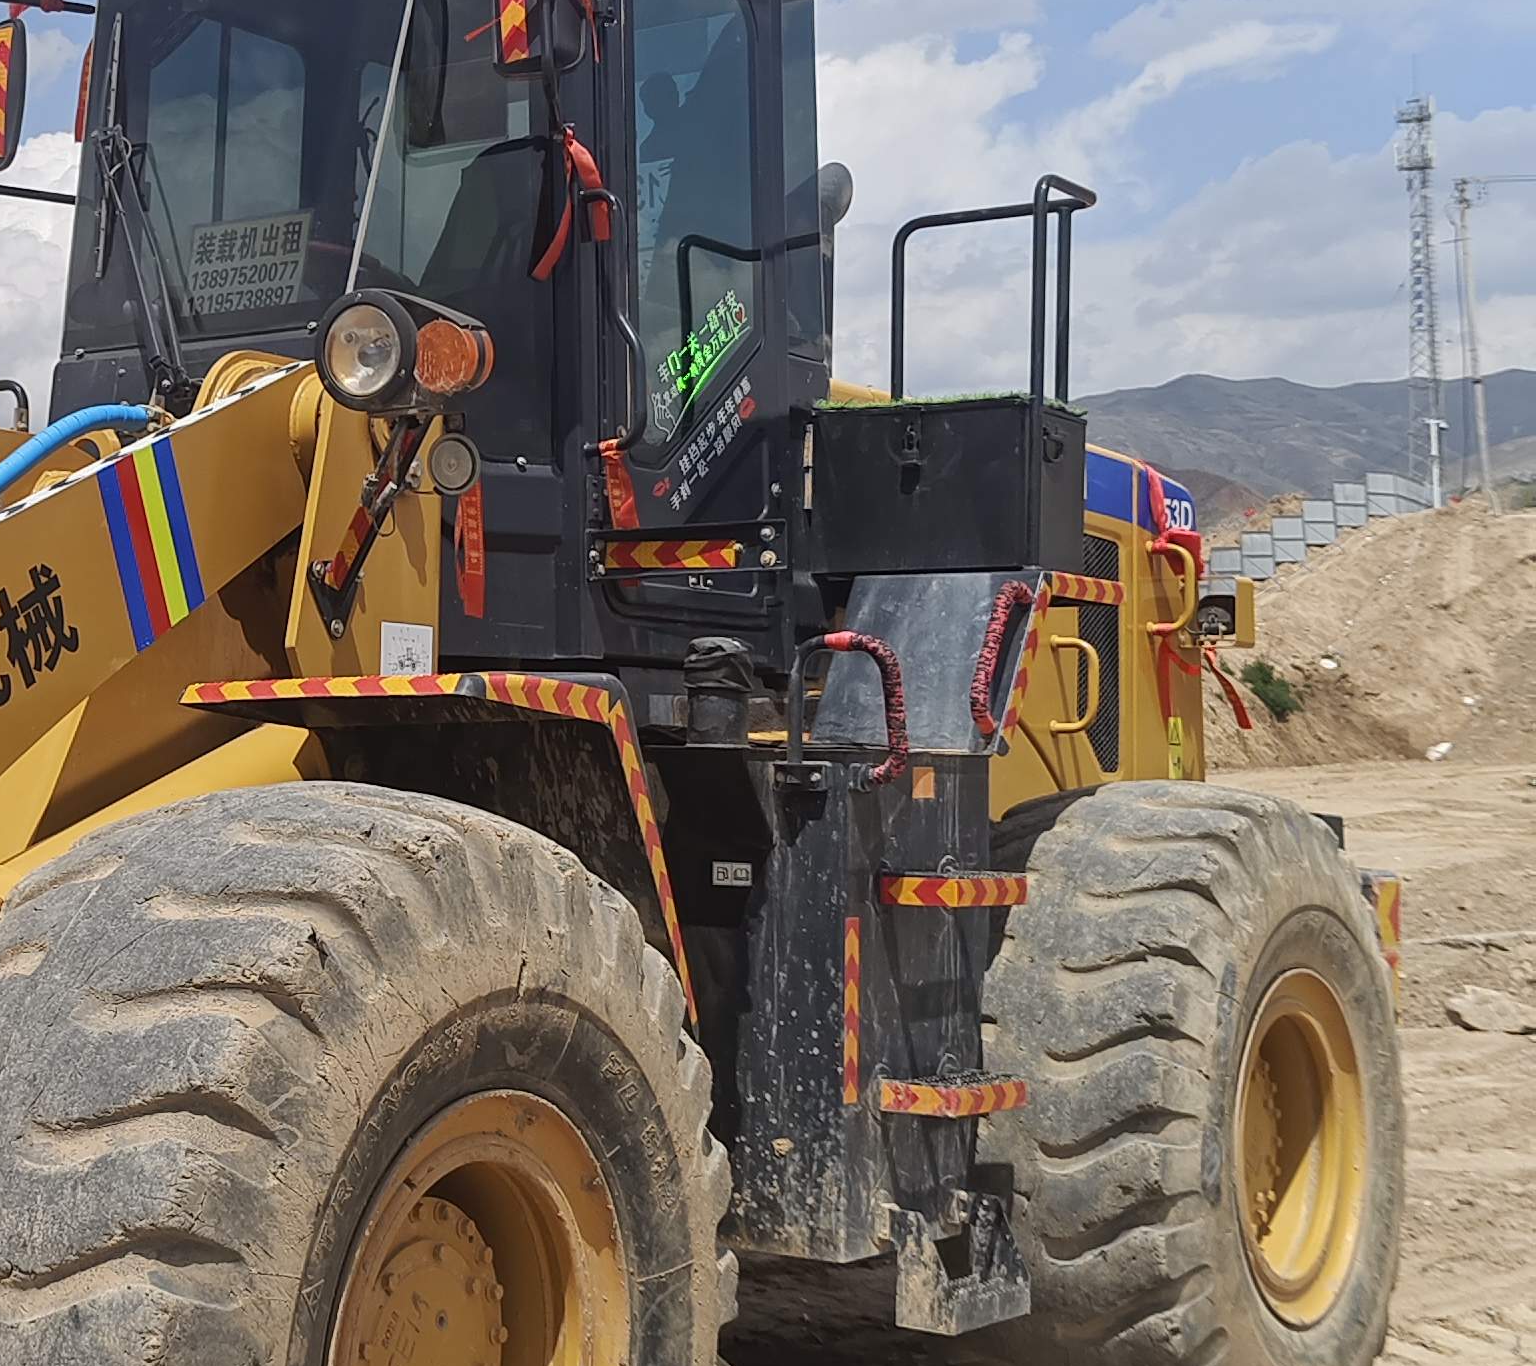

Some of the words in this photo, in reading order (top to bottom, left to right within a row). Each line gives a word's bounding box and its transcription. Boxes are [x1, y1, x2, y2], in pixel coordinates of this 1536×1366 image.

[194, 220, 304, 266] 装载机出租
[192, 260, 300, 292] 13897520077
[187, 285, 295, 316] 13195738897
